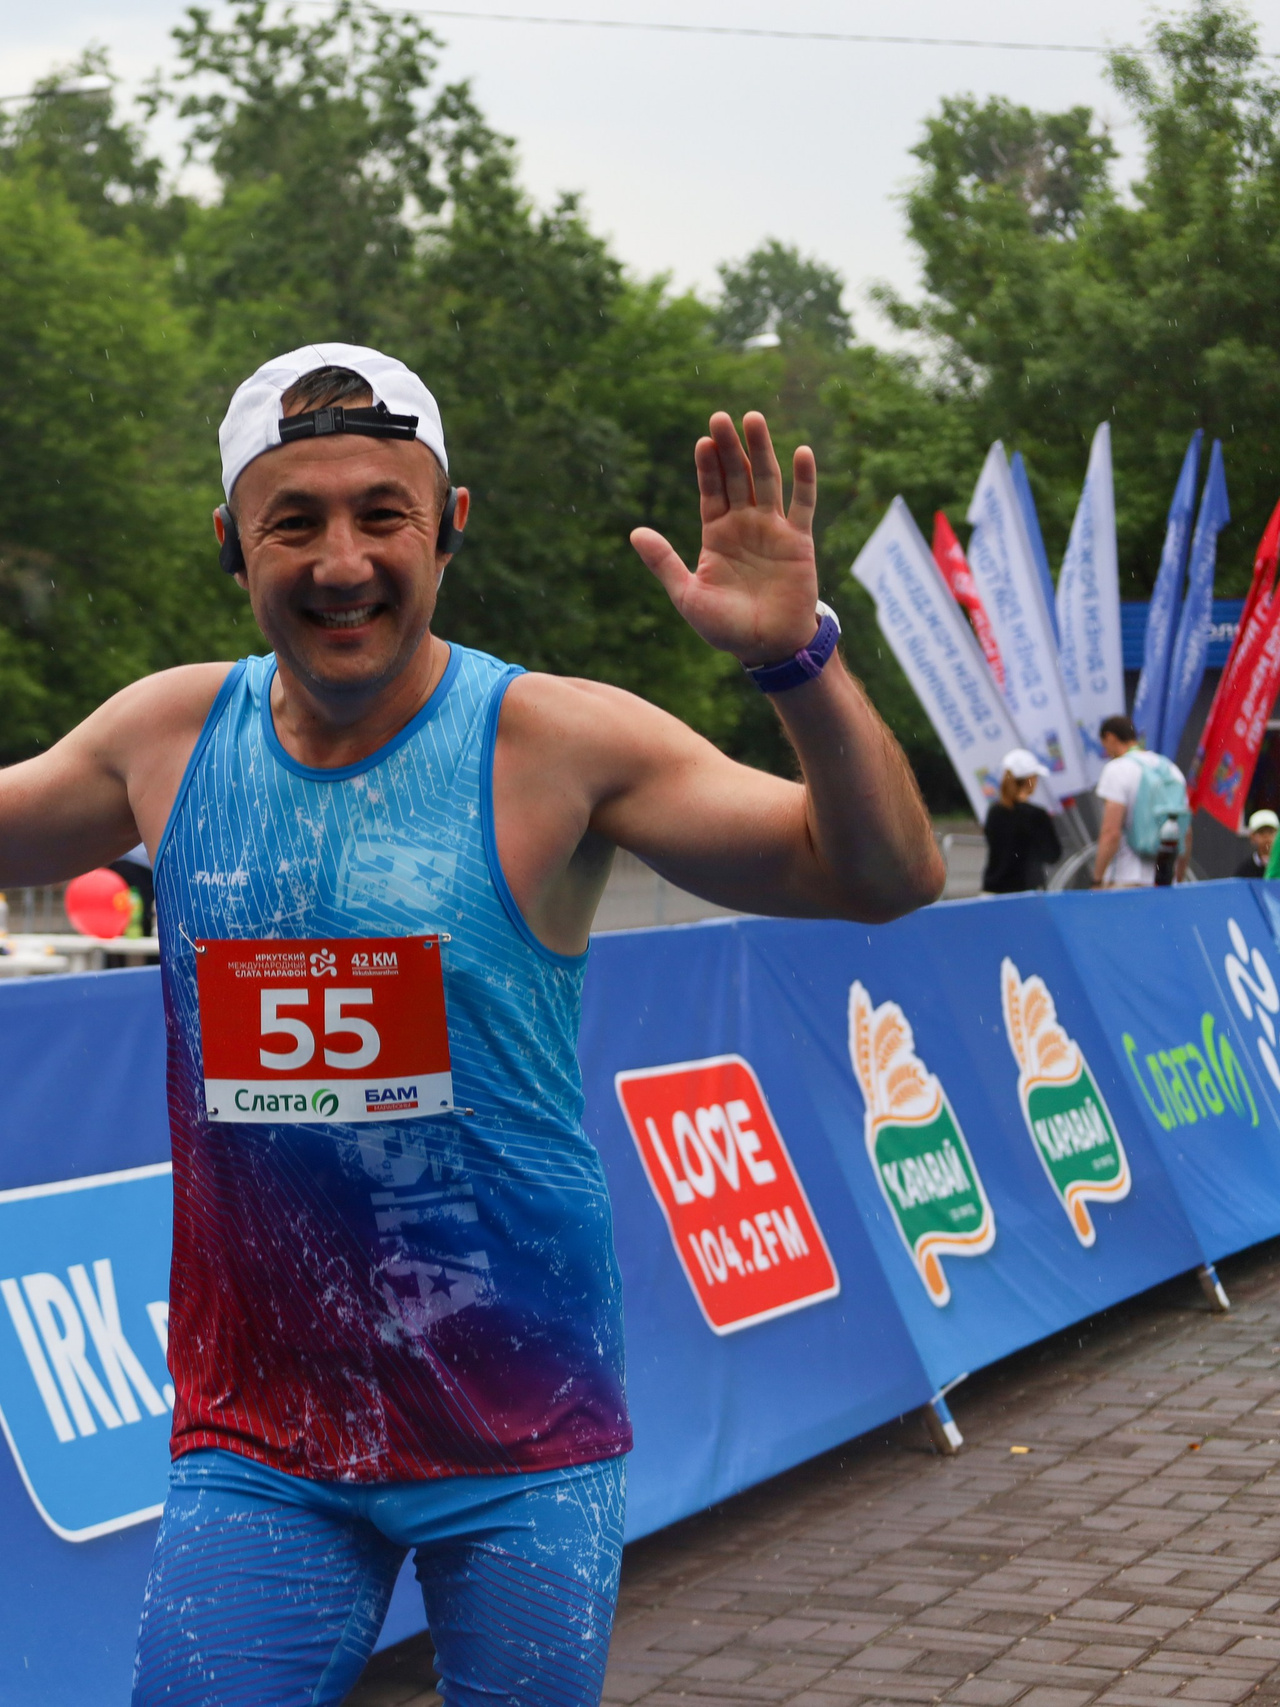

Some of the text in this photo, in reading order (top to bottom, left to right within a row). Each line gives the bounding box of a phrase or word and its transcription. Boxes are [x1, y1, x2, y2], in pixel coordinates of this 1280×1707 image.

[227, 961, 306, 970] МЕЖДУНАРОДНЫЙ
[255, 951, 306, 962] ИРКУТСКИЙ
[351, 953, 369, 967] 42
[235, 968, 307, 978] СЛАТА МАРАФОН
[259, 987, 381, 1071] 55
[234, 1088, 308, 1113] Слата
[364, 1085, 418, 1103] БАМ
[1034, 1096, 1111, 1163] КАРАВАЙ
[645, 1099, 777, 1205] LOVE
[881, 1138, 972, 1211] КАРАВАЙ
